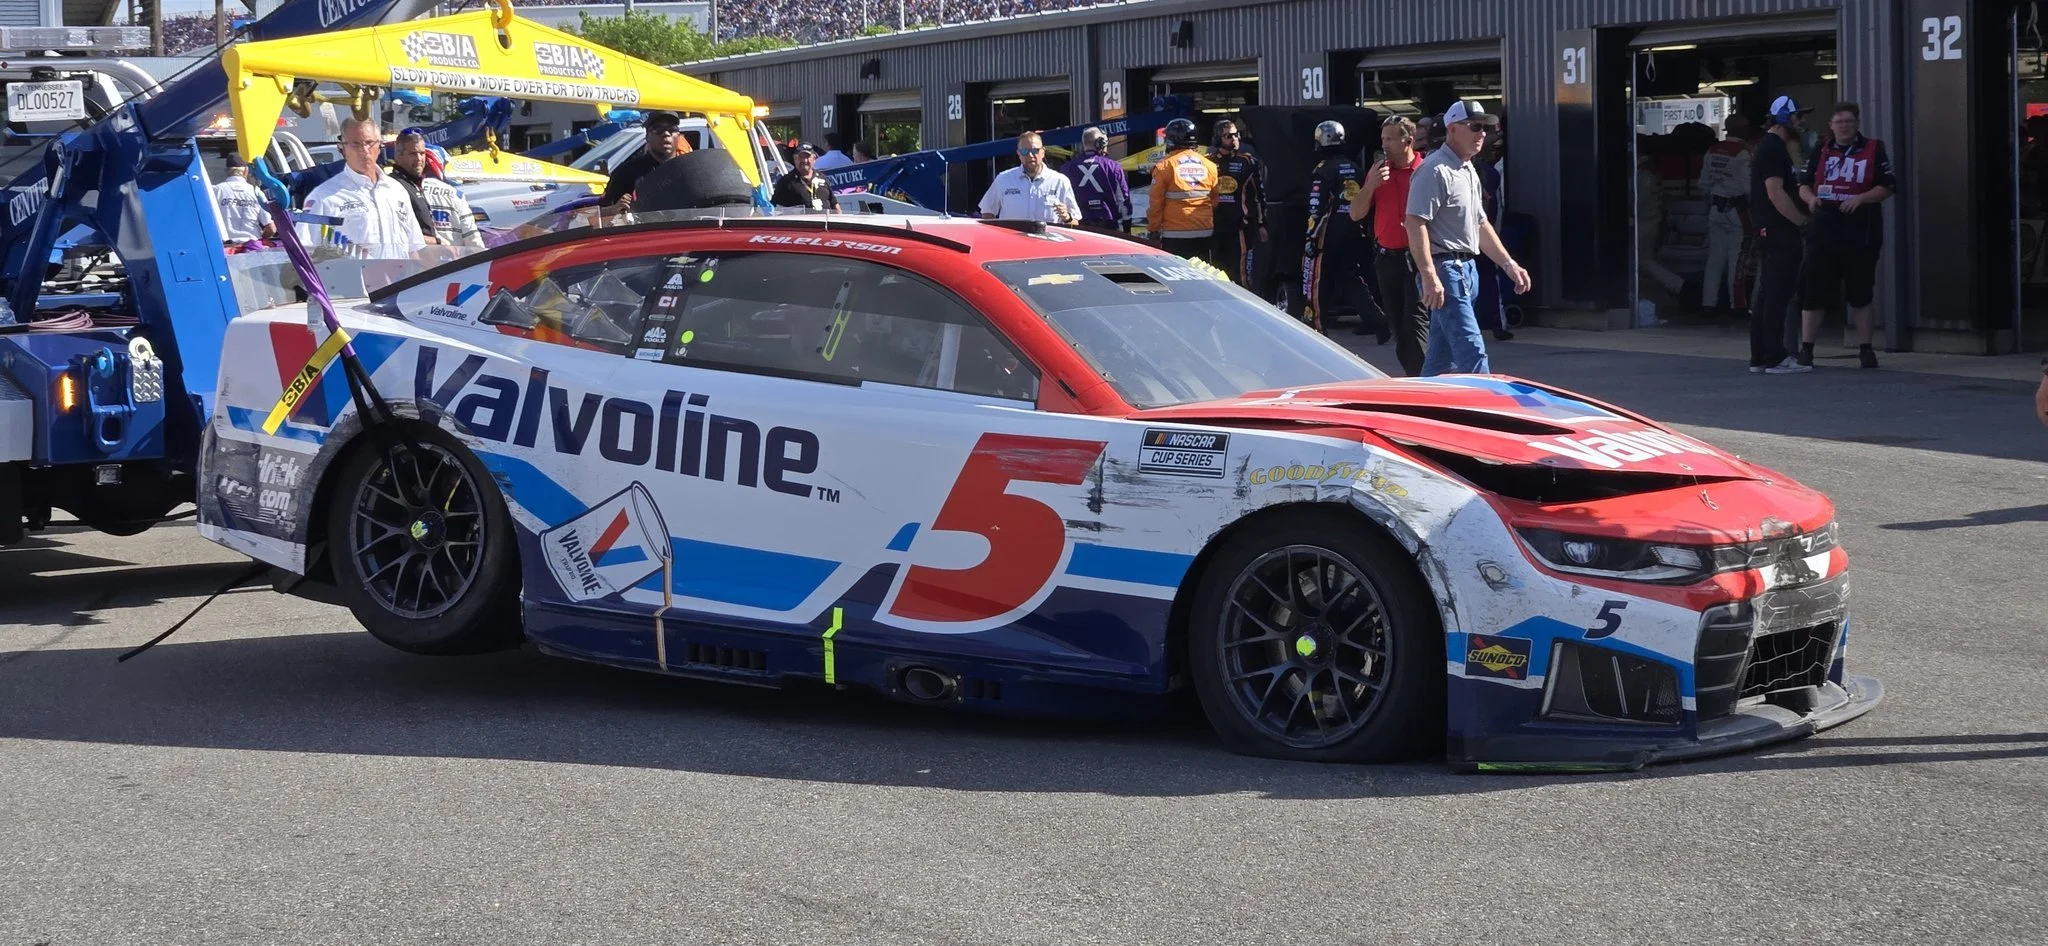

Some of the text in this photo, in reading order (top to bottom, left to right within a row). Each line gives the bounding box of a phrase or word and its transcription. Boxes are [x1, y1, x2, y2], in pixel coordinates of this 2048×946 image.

[441, 33, 477, 58] B/A
[1922, 15, 1962, 60] 32
[428, 56, 480, 68] PRODUCTS CO.
[551, 46, 583, 67] B/A
[1563, 47, 1586, 84] 31
[539, 64, 586, 77] PRODUCTS CO.
[1302, 66, 1324, 99] 30
[394, 68, 637, 102] SLOW DOWN MOVE OVER FOR TOW TRUCKS
[1103, 81, 1122, 110] 29
[17, 92, 74, 110] DL00527
[948, 94, 962, 120] 28
[823, 104, 834, 128] 27
[1664, 109, 1696, 120] FIRST AID
[1077, 164, 1104, 193] X
[430, 306, 468, 321] Valvoline
[414, 345, 841, 504] Valvoline TM
[1168, 433, 1217, 448] NASCAR
[1151, 451, 1214, 467] CUP SERIES
[884, 432, 1109, 626] 5
[1583, 600, 1629, 640] 5
[1468, 650, 1527, 666] SUNOCO
